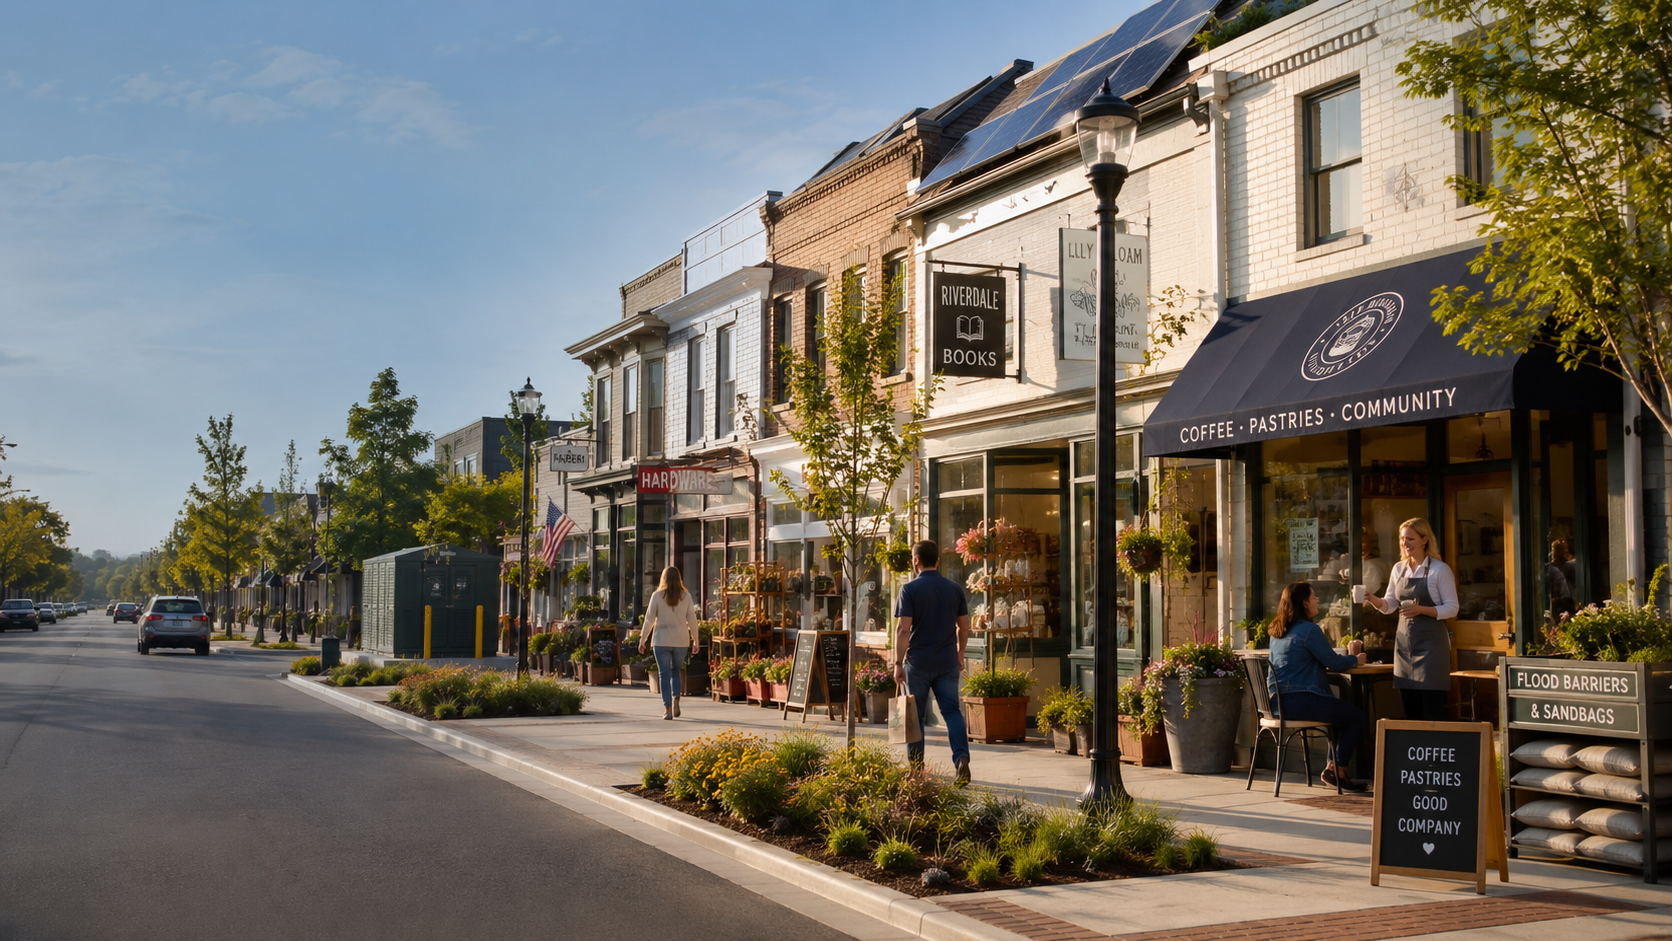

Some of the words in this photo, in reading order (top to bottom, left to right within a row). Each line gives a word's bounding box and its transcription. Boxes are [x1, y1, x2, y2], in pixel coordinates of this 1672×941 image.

[941, 285, 999, 310] RIVERDALE
[943, 348, 997, 367] BOOKS
[1180, 420, 1234, 444] COFFEE
[1249, 408, 1324, 434] PASTRIES
[1341, 387, 1457, 422] COMMUNITY
[641, 470, 716, 491] HARDWARE
[1517, 672, 1560, 690] FLOOD
[1563, 674, 1629, 694] BARRIERS
[1530, 703, 1540, 719] &
[1543, 703, 1615, 725] SANDBAGS
[1407, 746, 1456, 763] COFFEE
[1400, 769, 1462, 787] PASTRIES
[1412, 794, 1448, 812] GOOD
[1398, 817, 1461, 836] COMPANY
